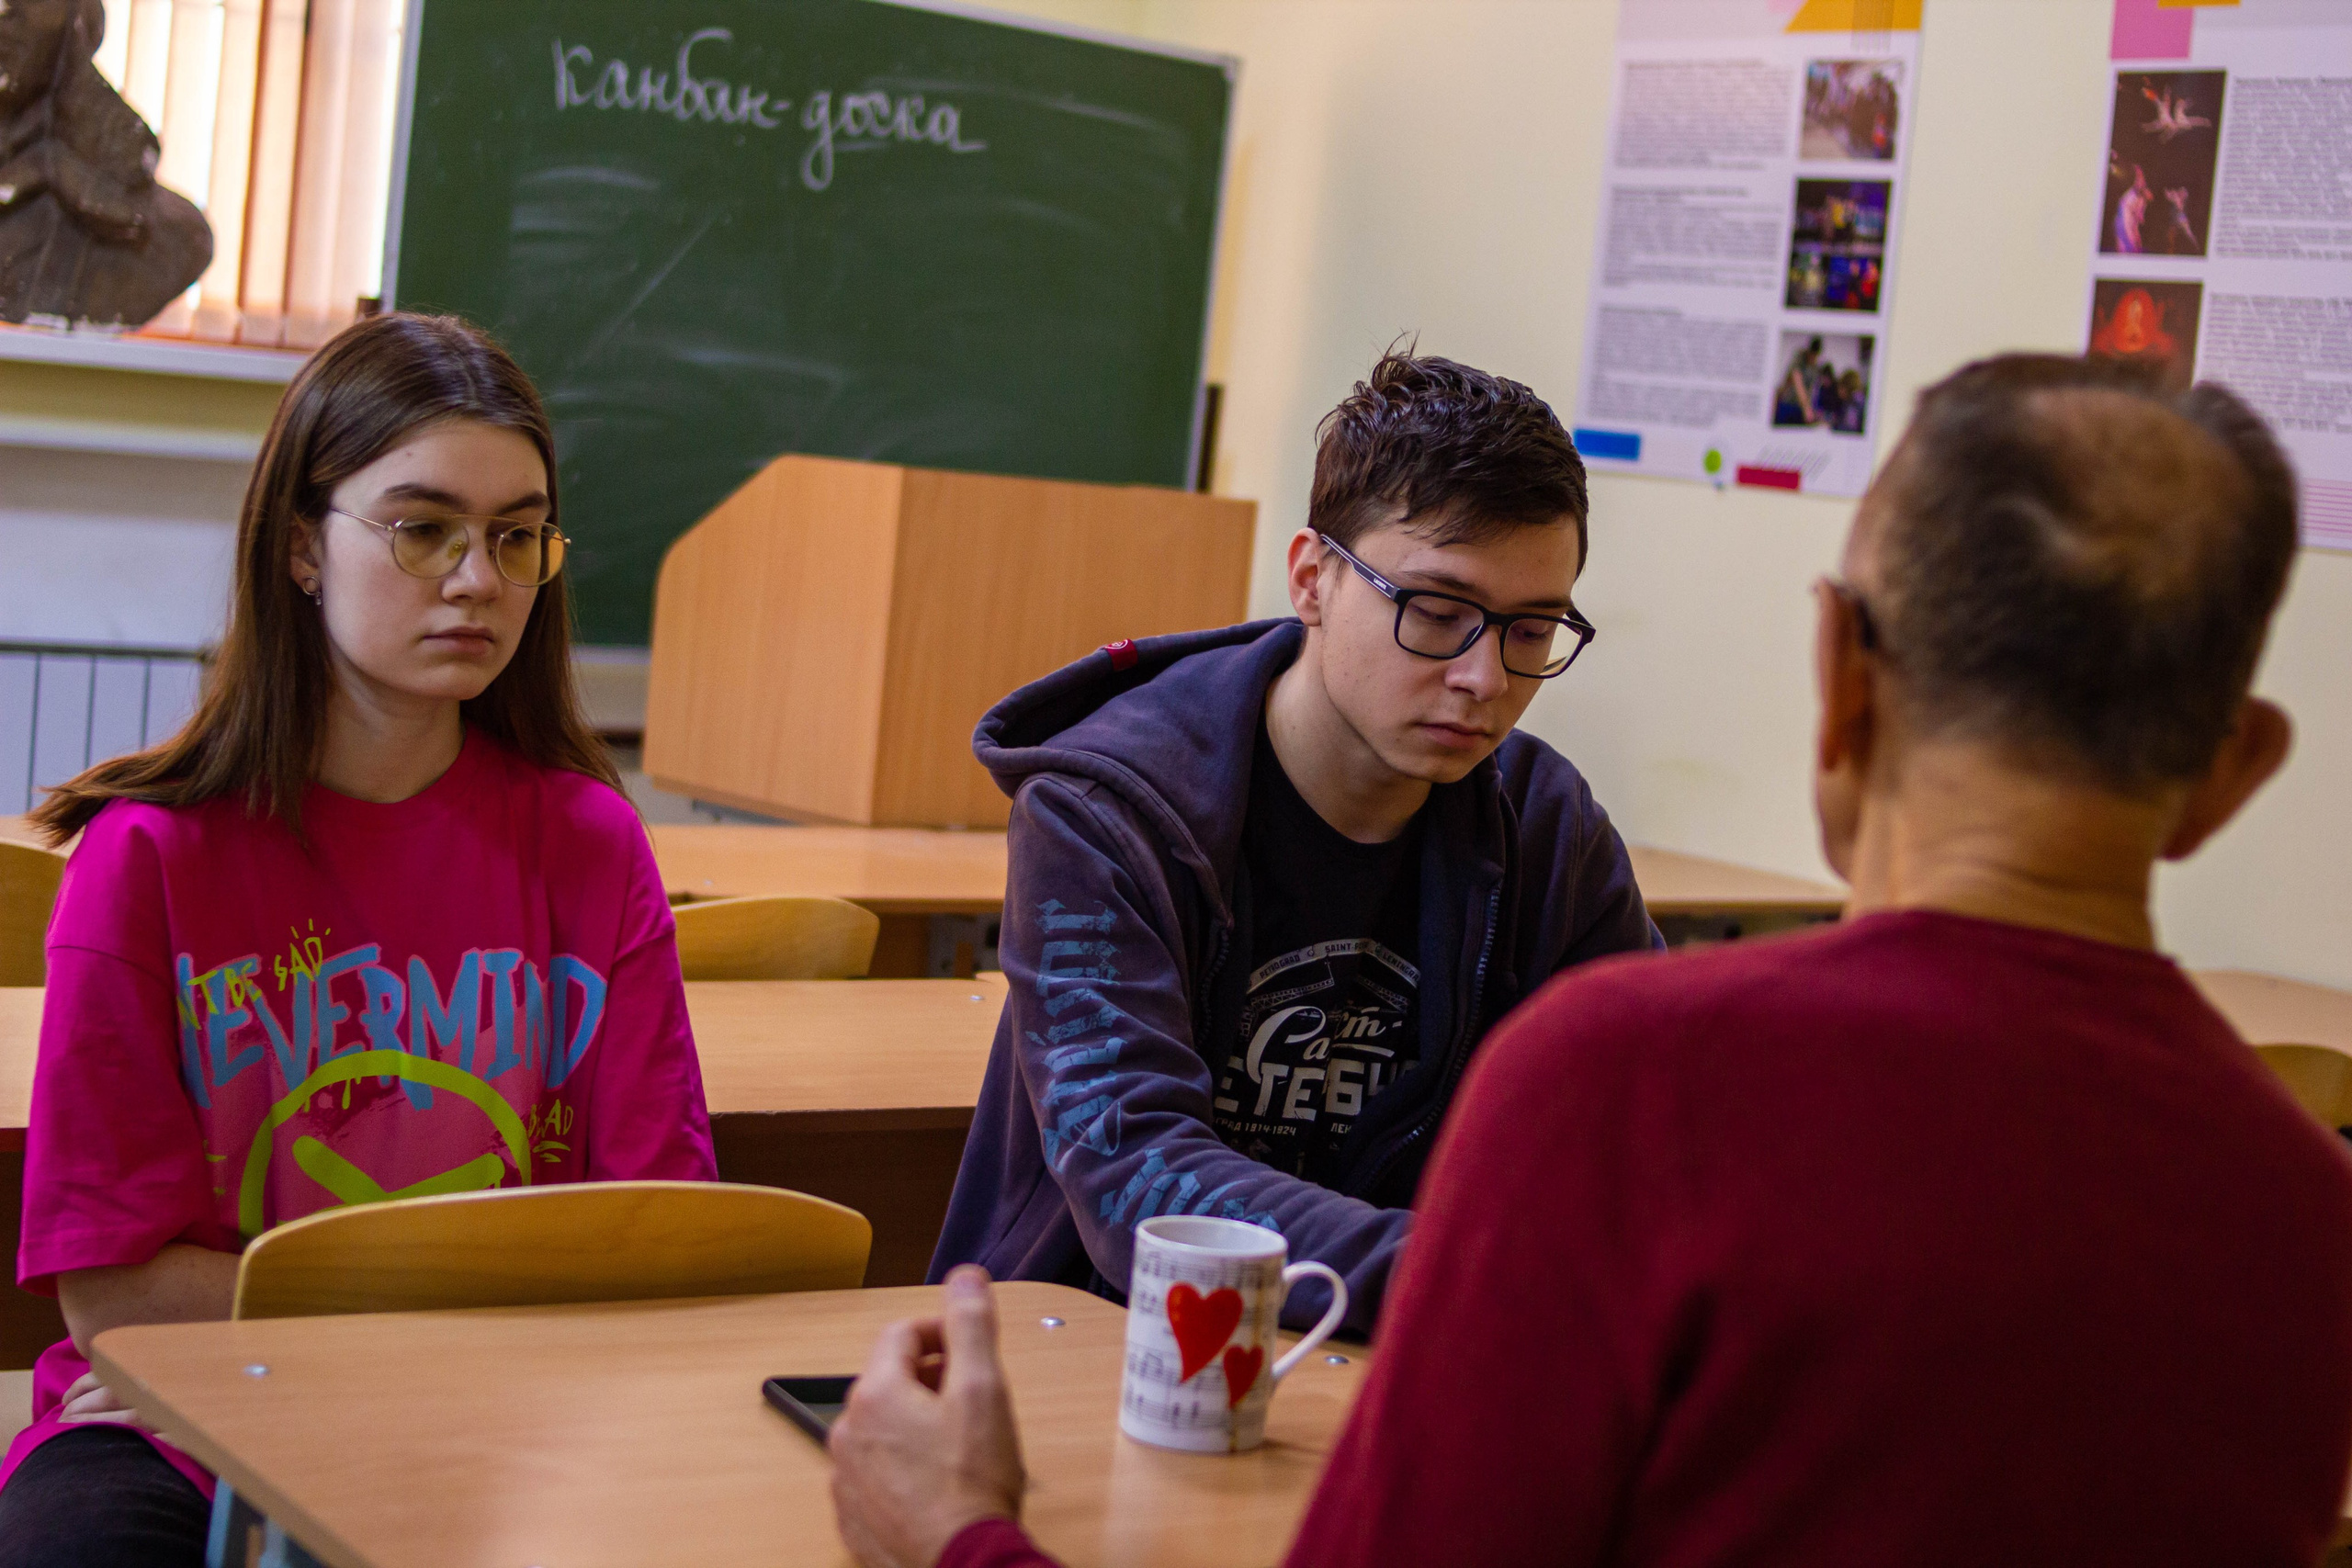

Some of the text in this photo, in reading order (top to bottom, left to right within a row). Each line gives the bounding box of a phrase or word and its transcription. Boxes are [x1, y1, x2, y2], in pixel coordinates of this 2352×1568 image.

[223, 962, 263, 1008] BE
[273, 936, 323, 993] SAD
[1259, 954, 1301, 979] PETROGRAD
[1382, 949, 1419, 981] LENINGRA
[1244, 1122, 1297, 1136] 1914-1924
